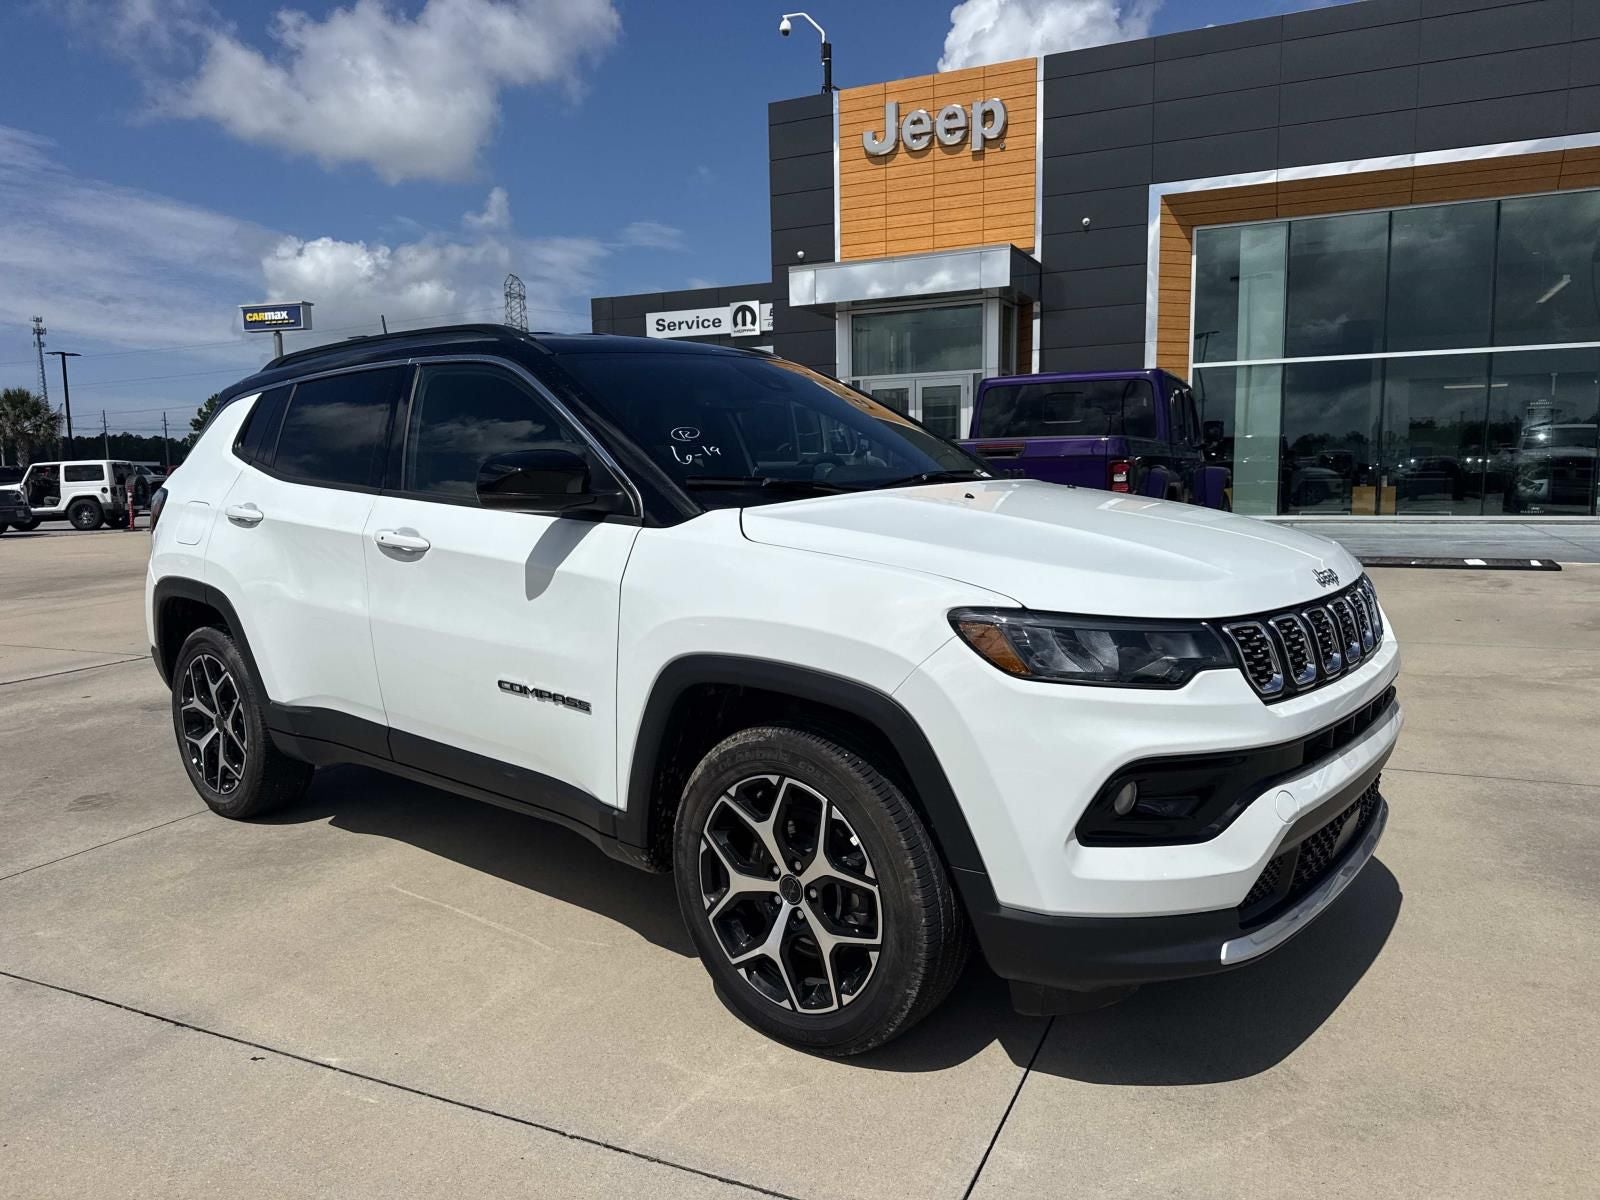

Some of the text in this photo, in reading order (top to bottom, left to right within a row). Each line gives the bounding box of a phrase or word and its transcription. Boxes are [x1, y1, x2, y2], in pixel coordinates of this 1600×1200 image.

[862, 97, 1007, 155] Jeep
[655, 315, 722, 332] Service
[1311, 568, 1340, 588] Jeep
[497, 679, 592, 713] COMPASS
